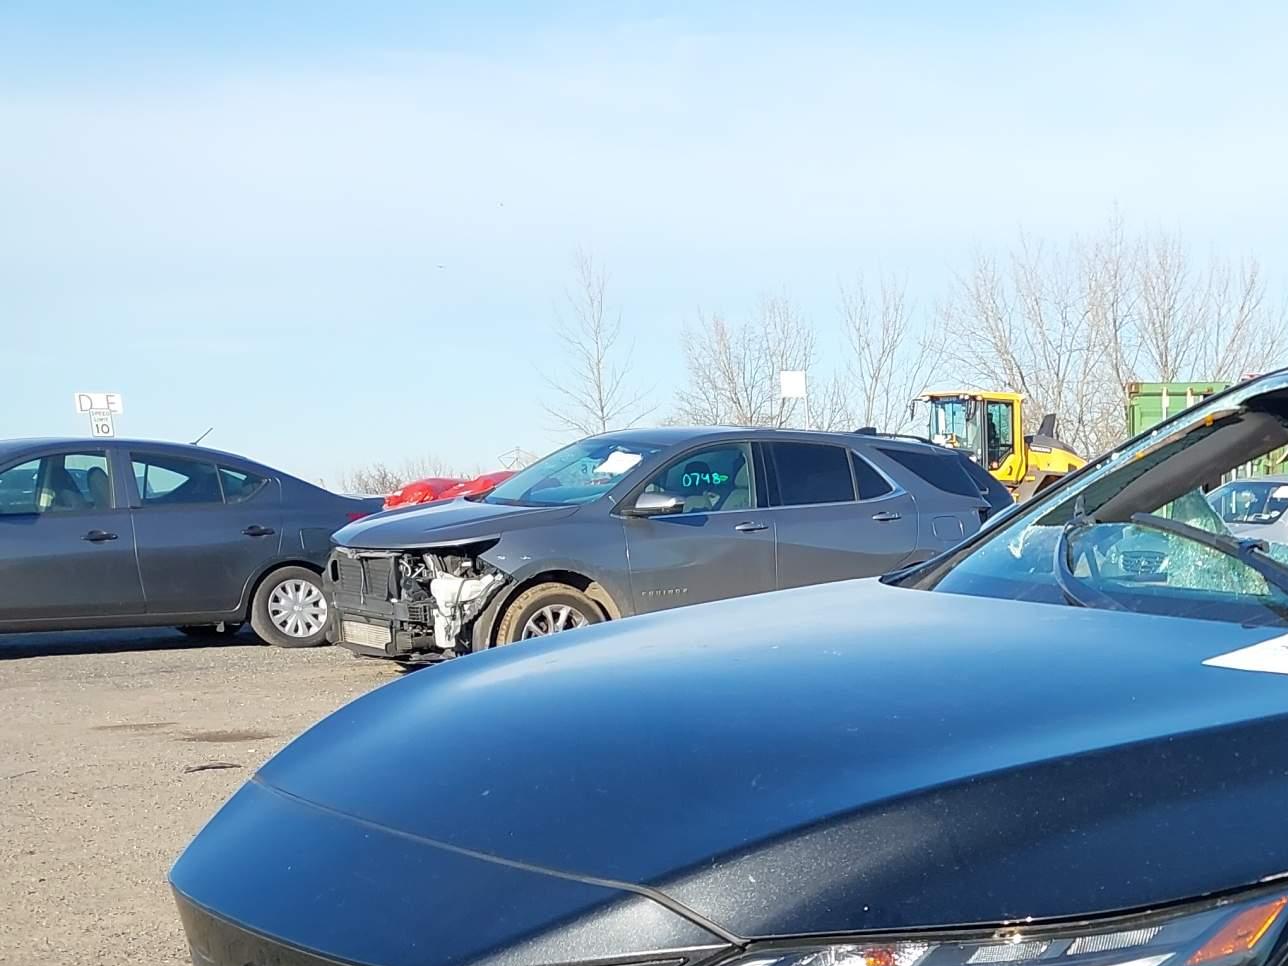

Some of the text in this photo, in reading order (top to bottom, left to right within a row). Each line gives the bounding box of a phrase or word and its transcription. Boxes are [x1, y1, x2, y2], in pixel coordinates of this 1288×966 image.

[79, 394, 118, 412] D E
[96, 424, 110, 434] 10
[682, 472, 721, 487] 0748
